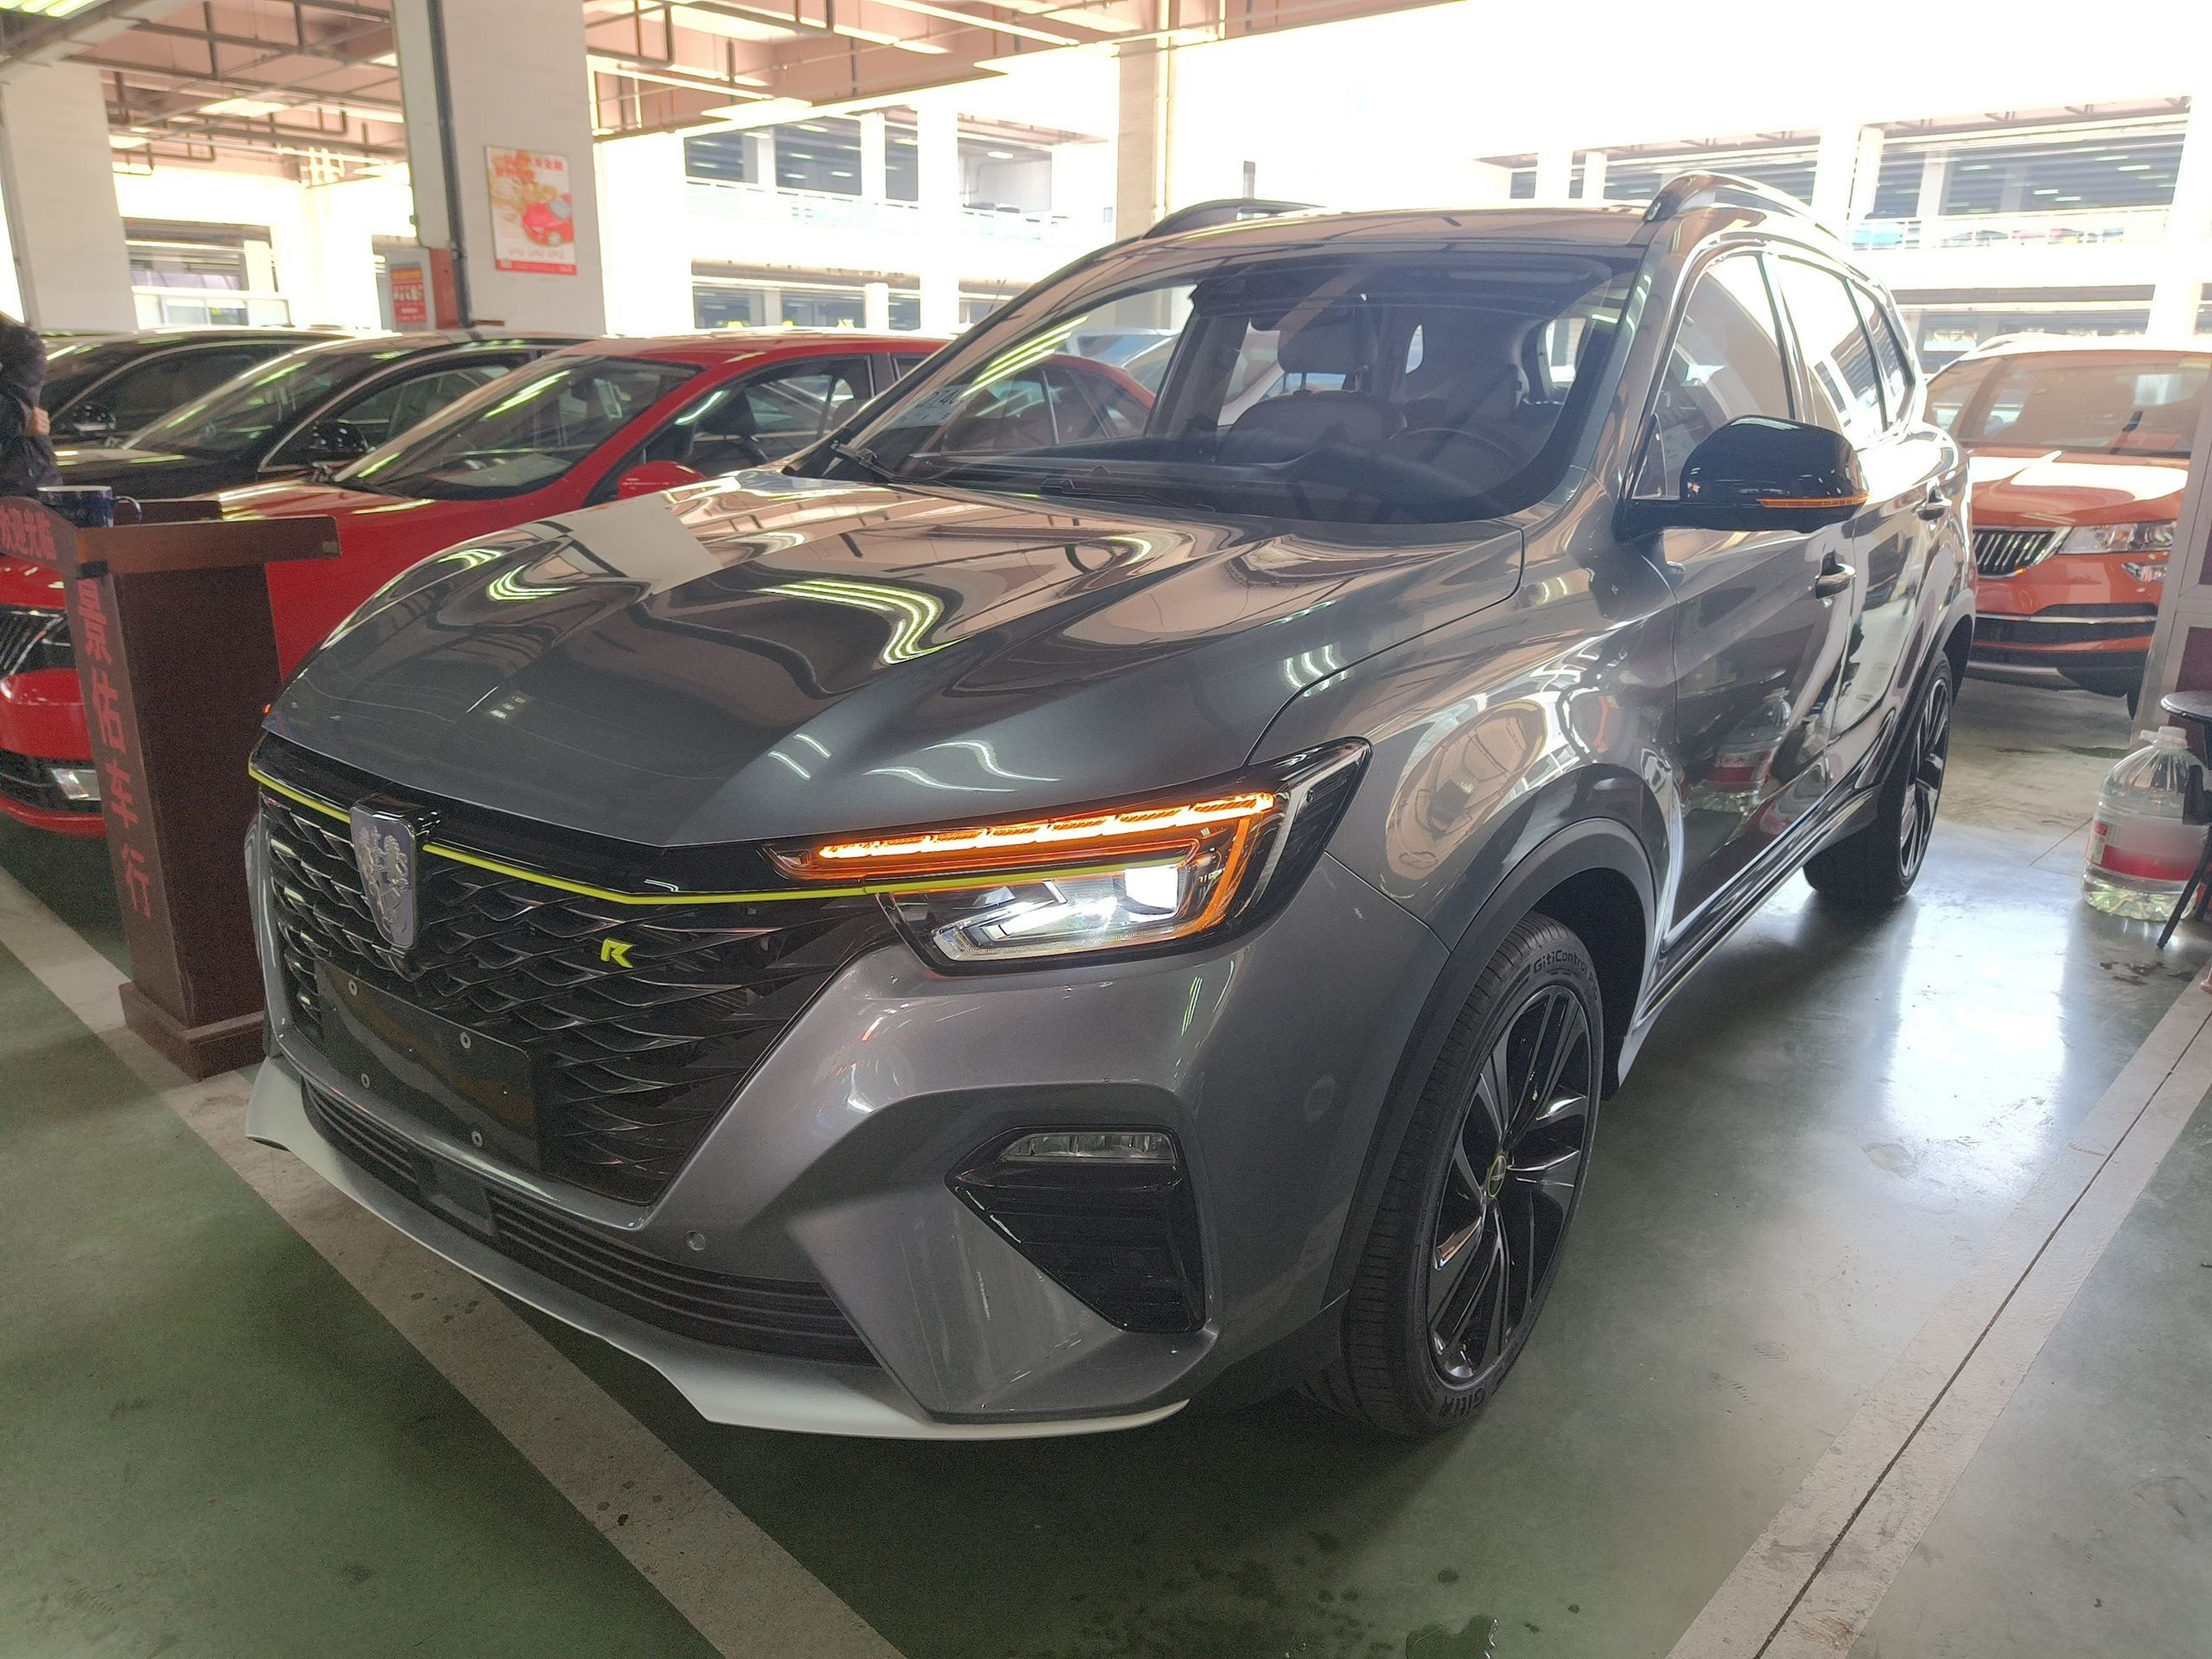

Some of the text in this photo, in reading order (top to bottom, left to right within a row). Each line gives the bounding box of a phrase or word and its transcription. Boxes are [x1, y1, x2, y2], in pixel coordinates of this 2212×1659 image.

[77, 579, 150, 918] 景佑车行
[1533, 949, 1587, 974] GitiControl
